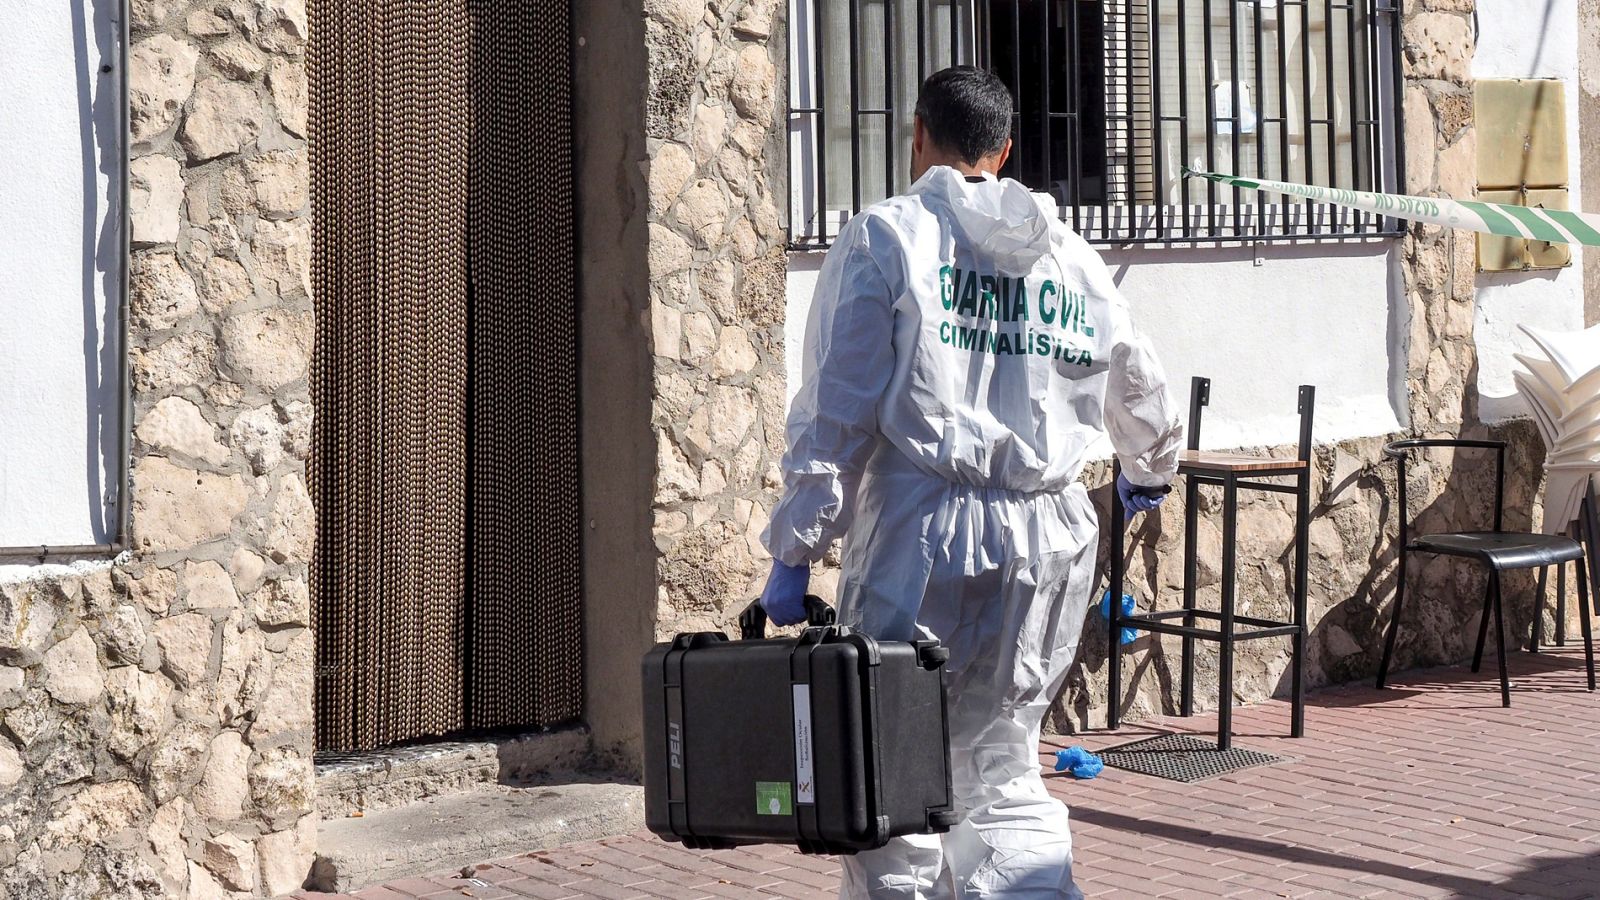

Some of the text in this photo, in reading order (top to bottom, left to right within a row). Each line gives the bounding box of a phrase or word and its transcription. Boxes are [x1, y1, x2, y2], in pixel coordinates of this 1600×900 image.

[1038, 279, 1095, 338] CVIL
[939, 320, 1093, 367] CIMINALÍSICA
[669, 722, 681, 769] PELI
